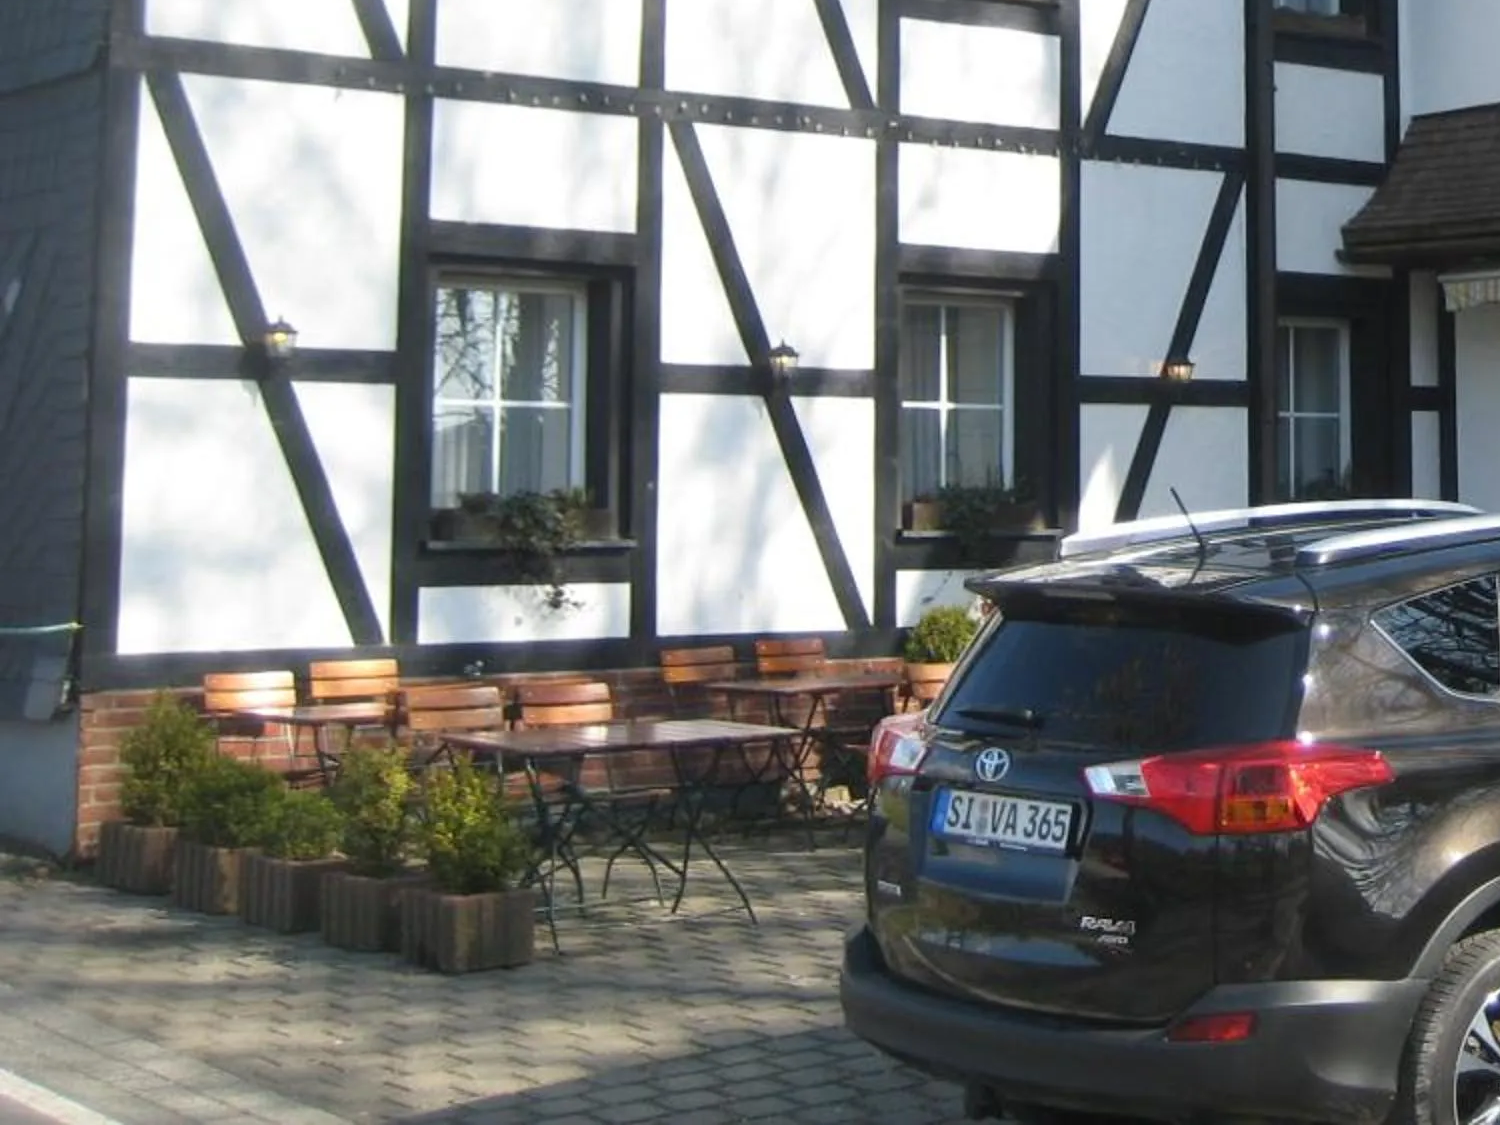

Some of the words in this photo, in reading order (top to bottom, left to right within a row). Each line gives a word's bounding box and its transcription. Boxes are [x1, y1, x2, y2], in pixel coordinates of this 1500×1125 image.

[947, 795, 974, 829] SI
[991, 800, 1018, 835] VA
[1023, 804, 1069, 841] 365
